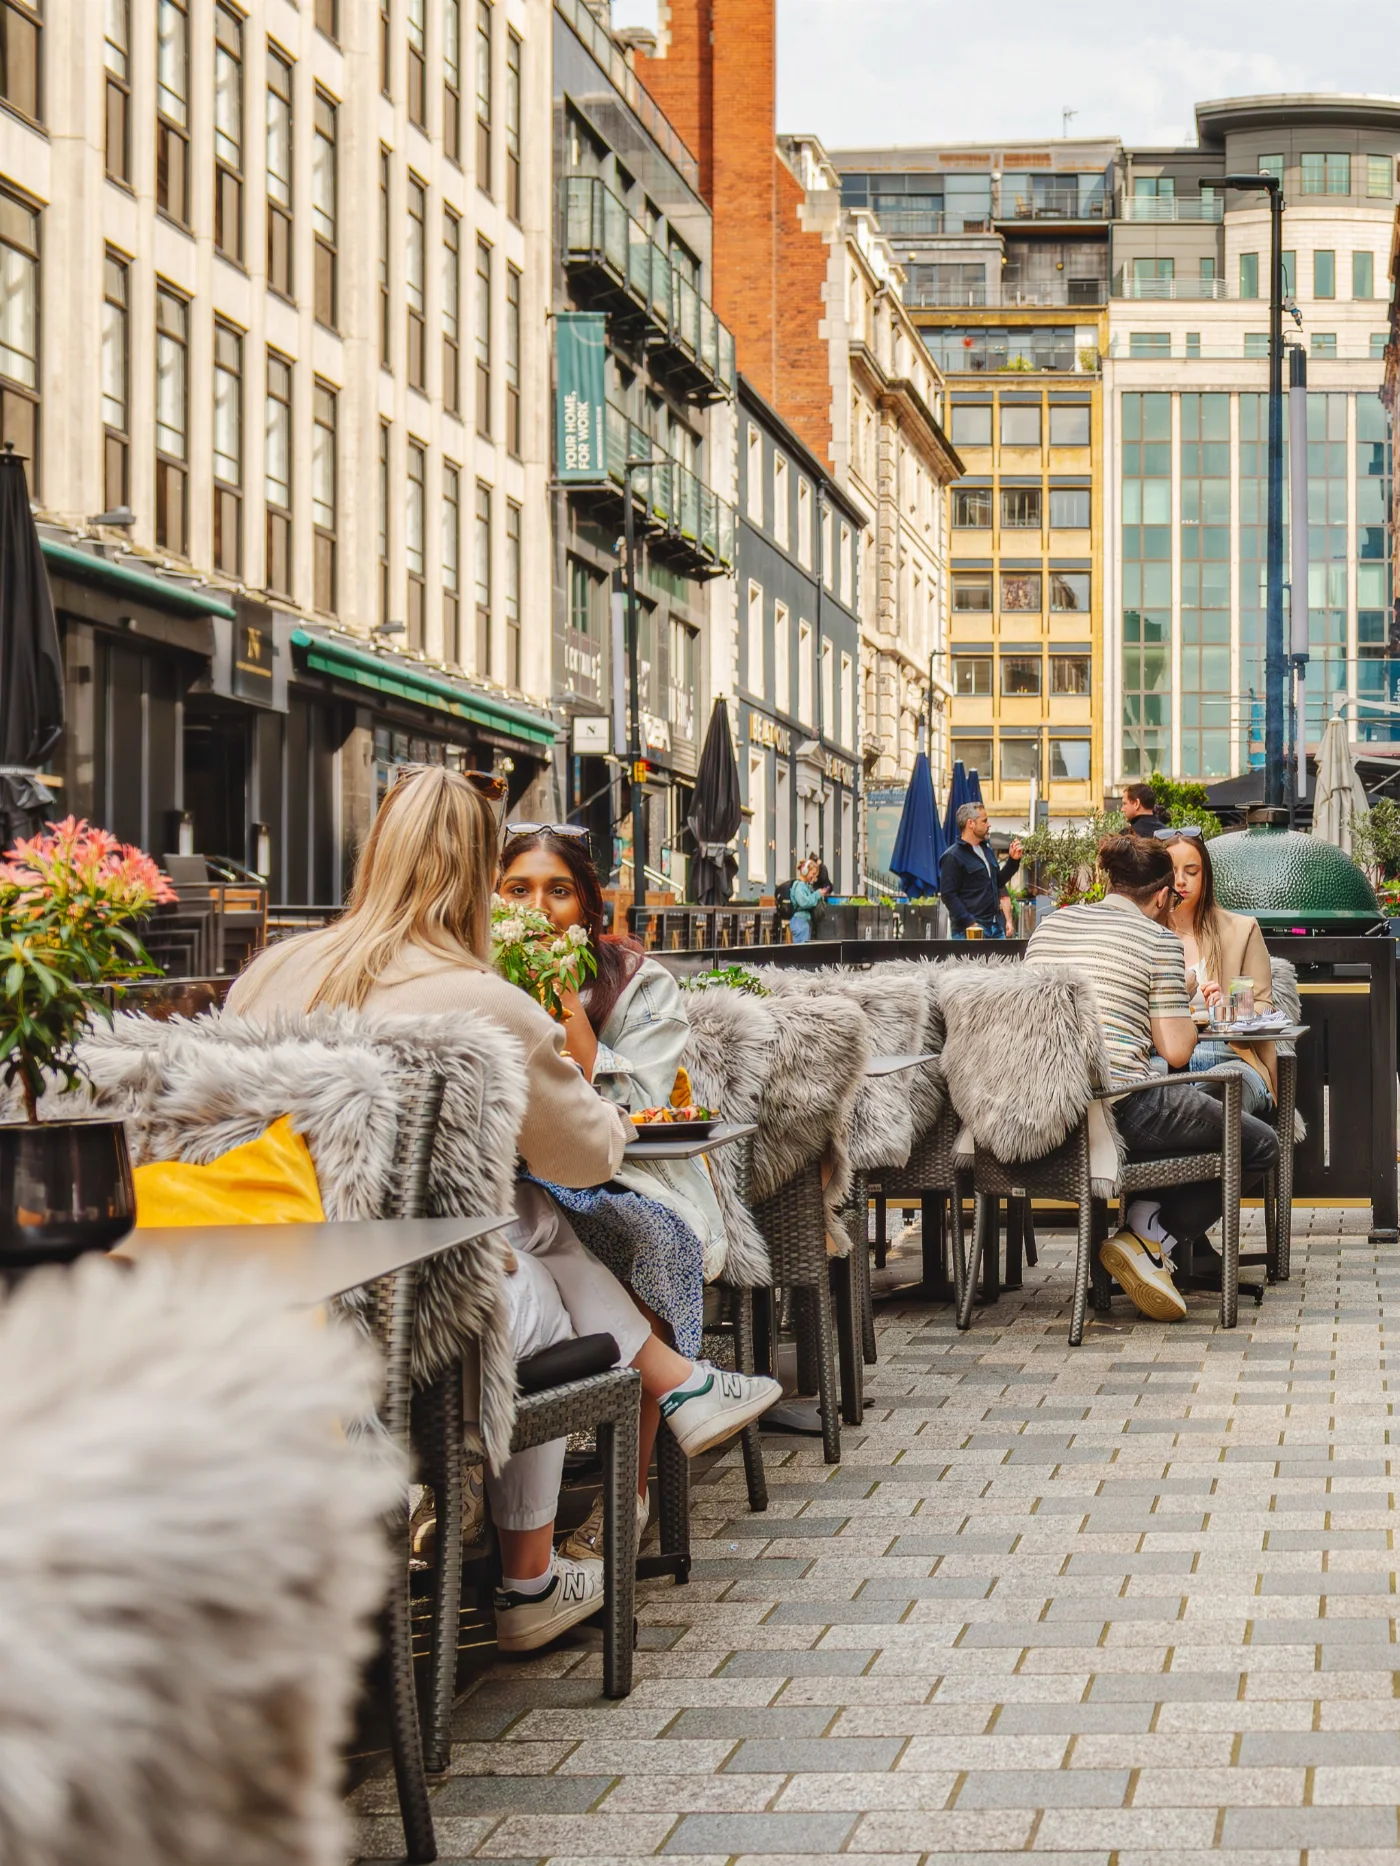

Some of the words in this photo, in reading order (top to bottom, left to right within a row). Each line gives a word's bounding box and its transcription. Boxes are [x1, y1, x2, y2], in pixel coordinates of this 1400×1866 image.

[564, 390, 578, 433] HOME,
[577, 401, 590, 442] WORK
[565, 435, 577, 470] YOUR
[578, 443, 591, 470] FOR
[721, 1373, 741, 1398] N
[563, 1572, 585, 1600] N
